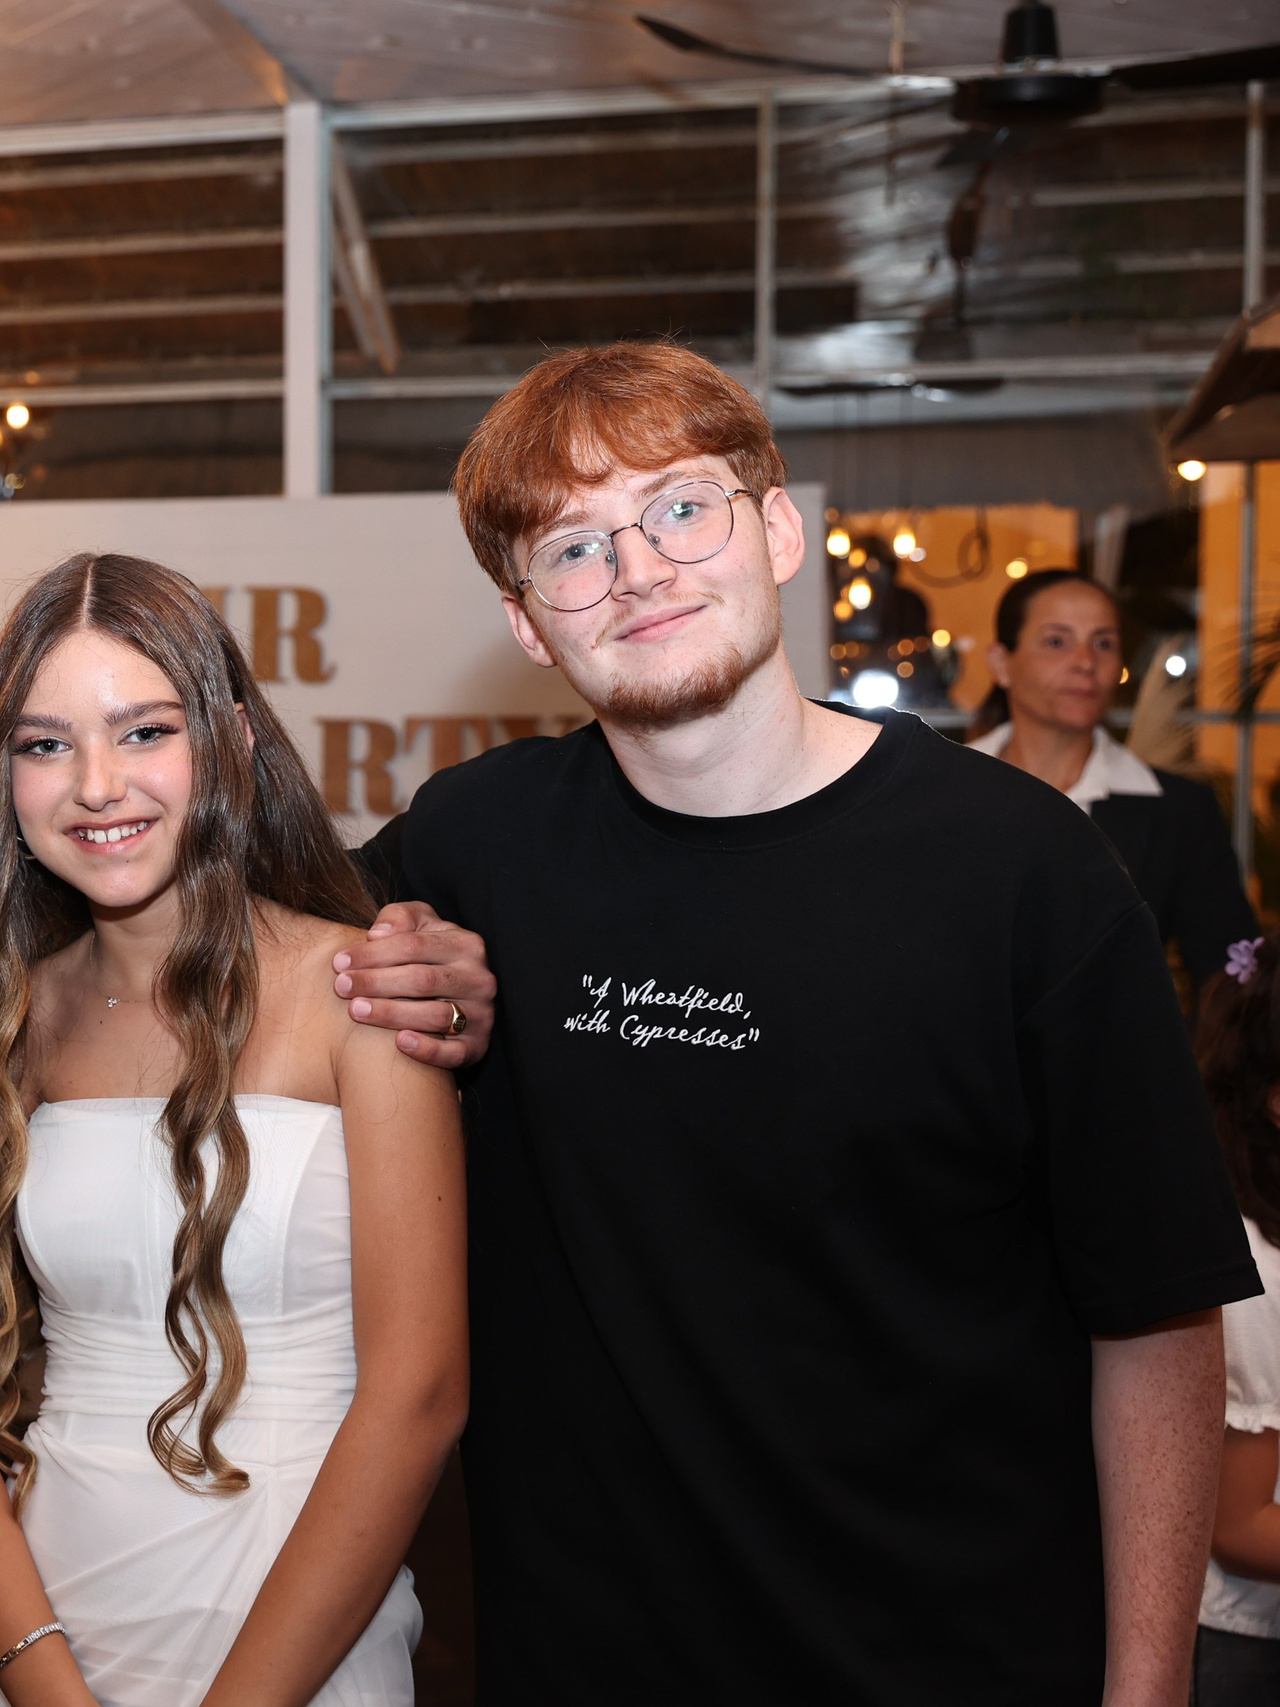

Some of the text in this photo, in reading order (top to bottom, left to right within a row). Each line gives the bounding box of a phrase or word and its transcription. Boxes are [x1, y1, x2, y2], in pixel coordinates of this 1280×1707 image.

[621, 978, 752, 1020] Wheatfield,
[563, 1009, 760, 1050] with Cypresses"
